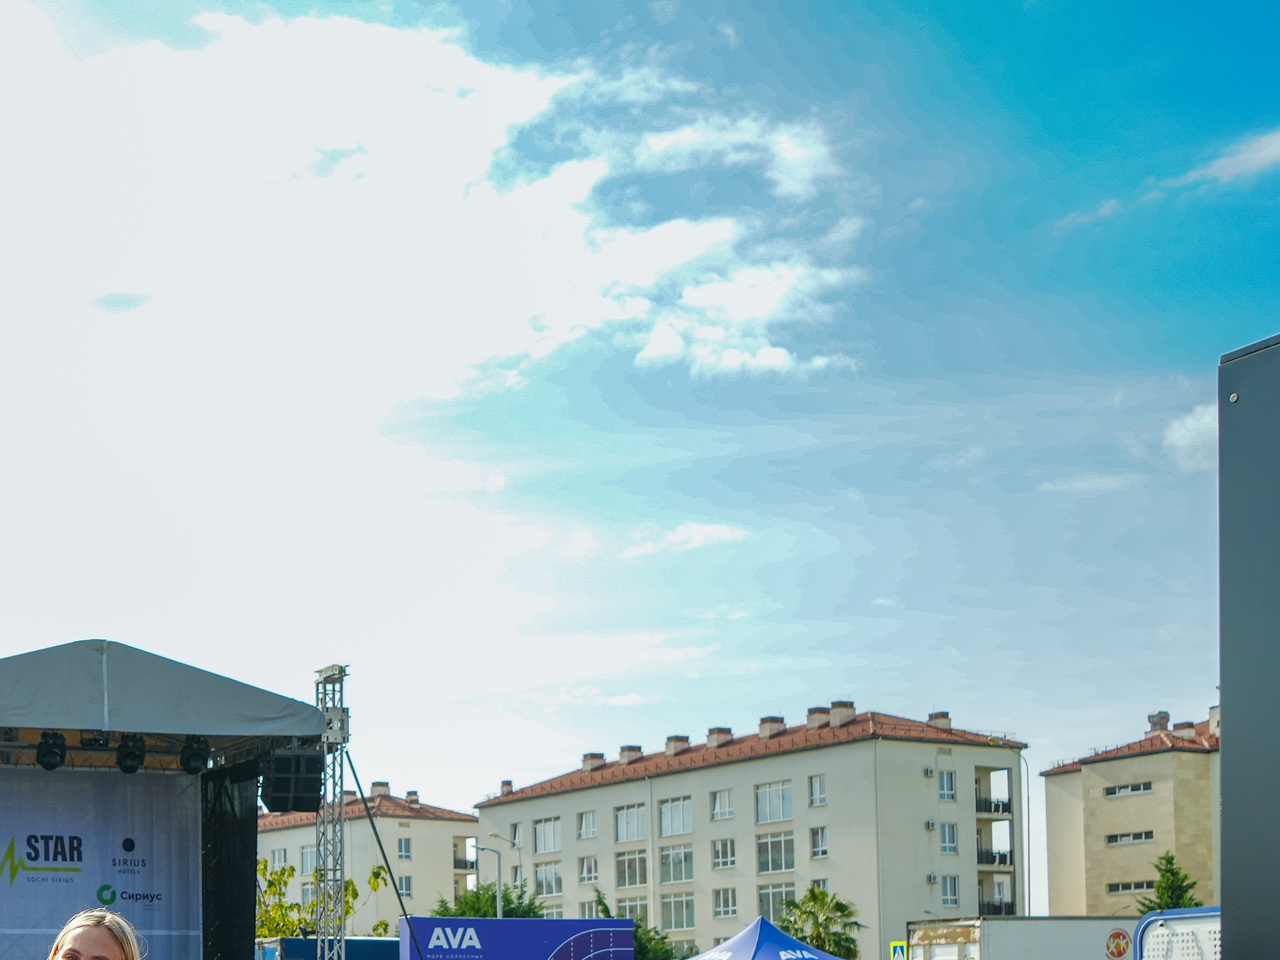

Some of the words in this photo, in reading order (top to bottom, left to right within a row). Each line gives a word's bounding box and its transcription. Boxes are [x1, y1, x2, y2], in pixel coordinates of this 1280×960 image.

[26, 835, 83, 862] STAR
[112, 858, 146, 868] SIRIUS
[120, 891, 162, 902] Сириус
[427, 927, 482, 950] AVA
[779, 950, 818, 960] AVA
